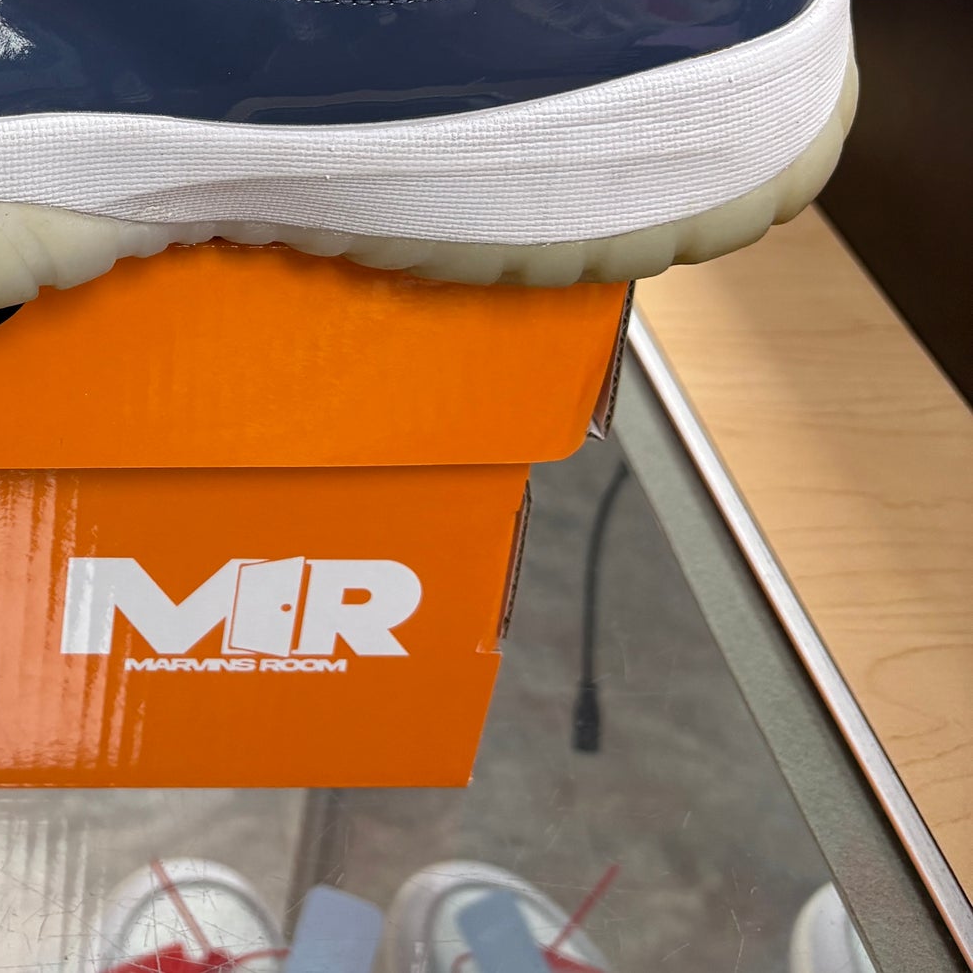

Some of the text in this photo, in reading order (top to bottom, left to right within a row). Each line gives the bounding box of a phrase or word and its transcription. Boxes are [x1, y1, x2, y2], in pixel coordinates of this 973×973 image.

[60, 556, 422, 657] MR
[124, 657, 348, 674] MARVINS ROOM
